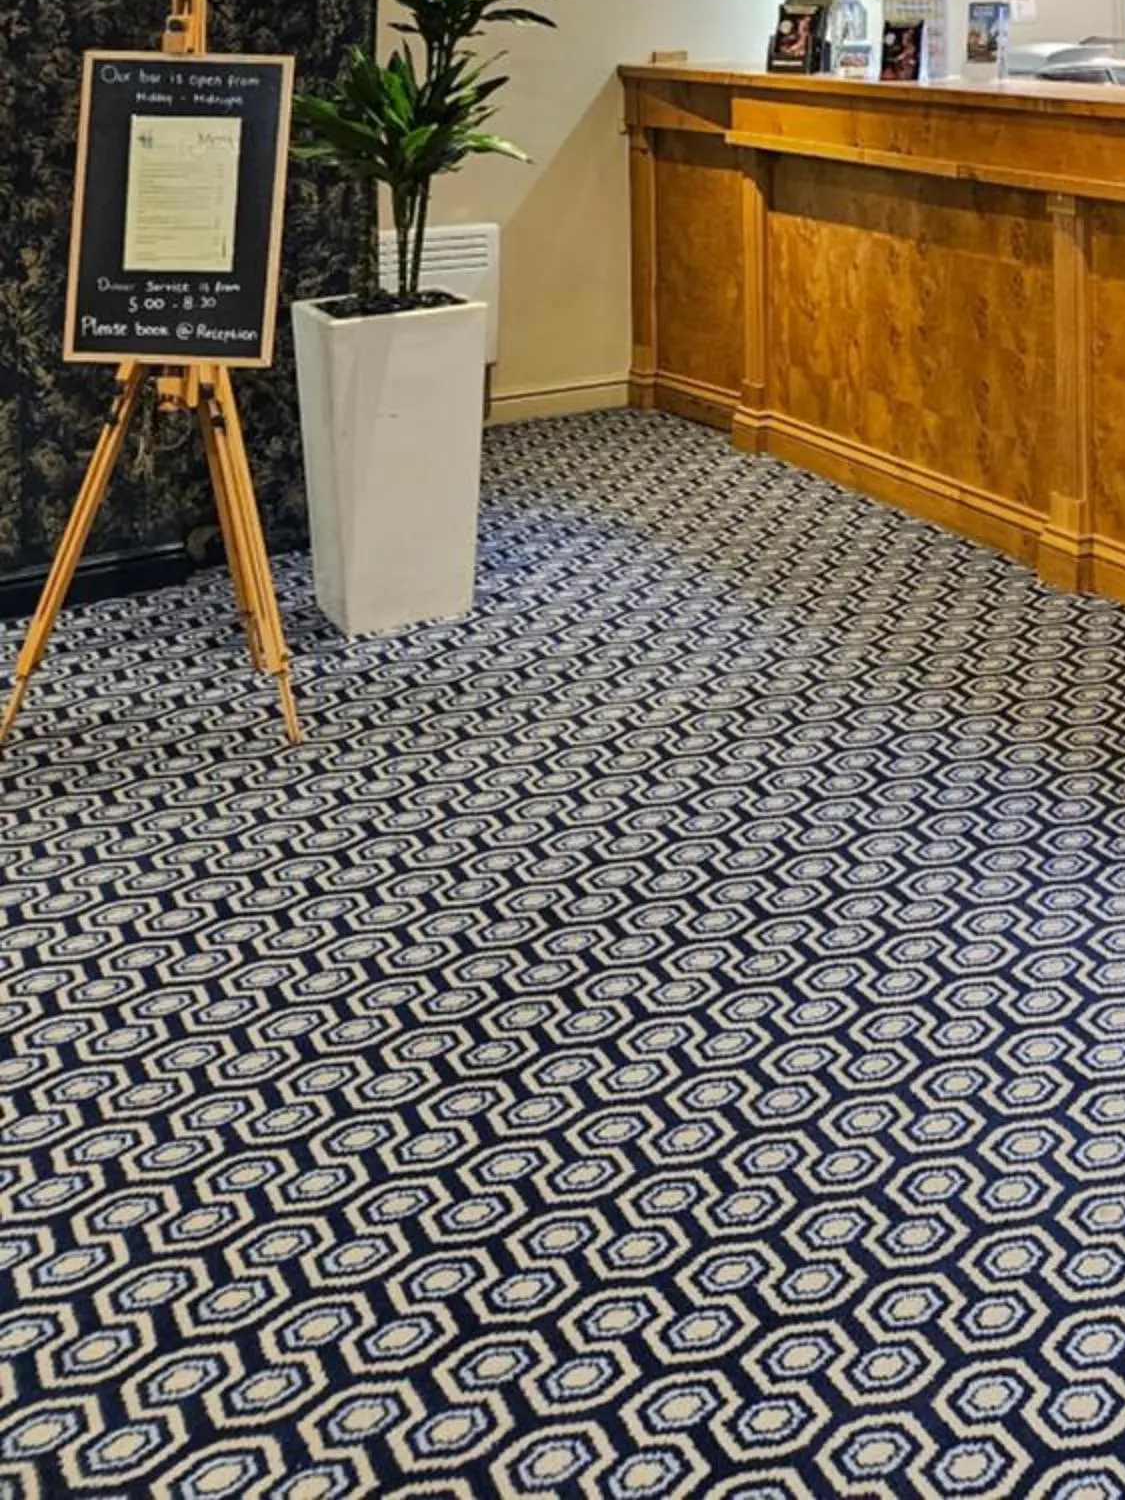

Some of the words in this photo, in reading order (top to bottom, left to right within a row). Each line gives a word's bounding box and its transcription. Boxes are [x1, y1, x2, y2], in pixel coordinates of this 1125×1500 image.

[100, 64, 130, 84] Our
[139, 68, 162, 83] bar
[170, 71, 183, 84] is
[189, 73, 222, 88] open
[228, 74, 260, 88] from
[81, 315, 128, 337] Please
[196, 323, 258, 343] Reception
